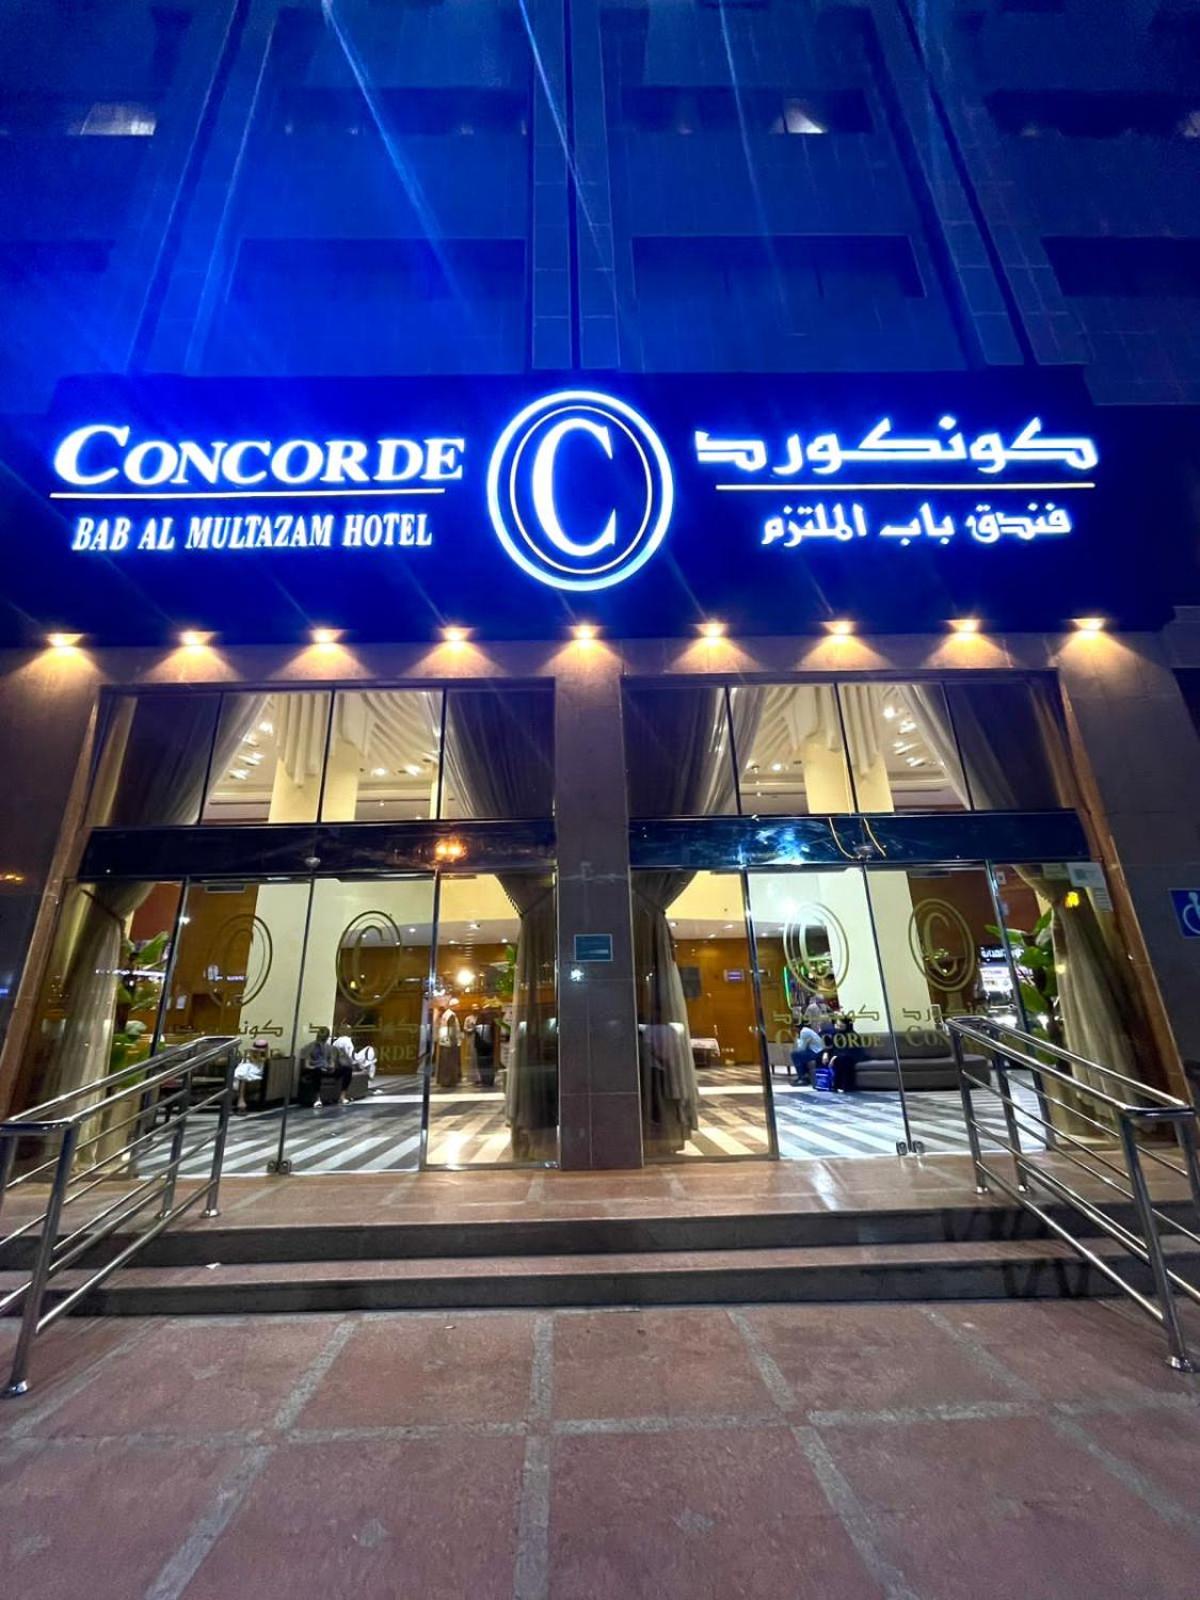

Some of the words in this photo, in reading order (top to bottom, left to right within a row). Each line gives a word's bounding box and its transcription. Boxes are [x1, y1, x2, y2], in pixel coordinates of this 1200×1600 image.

[54, 425, 464, 485] CONCORDE
[695, 416, 1097, 475] كونكورد
[532, 417, 617, 557] C
[72, 517, 131, 550] BAB
[138, 517, 174, 550] AL
[185, 515, 334, 548] MULTAZAM
[342, 513, 432, 546] HOTEL
[762, 503, 867, 547] الملتزم
[880, 503, 954, 545] باب
[966, 503, 1071, 543] فندق
